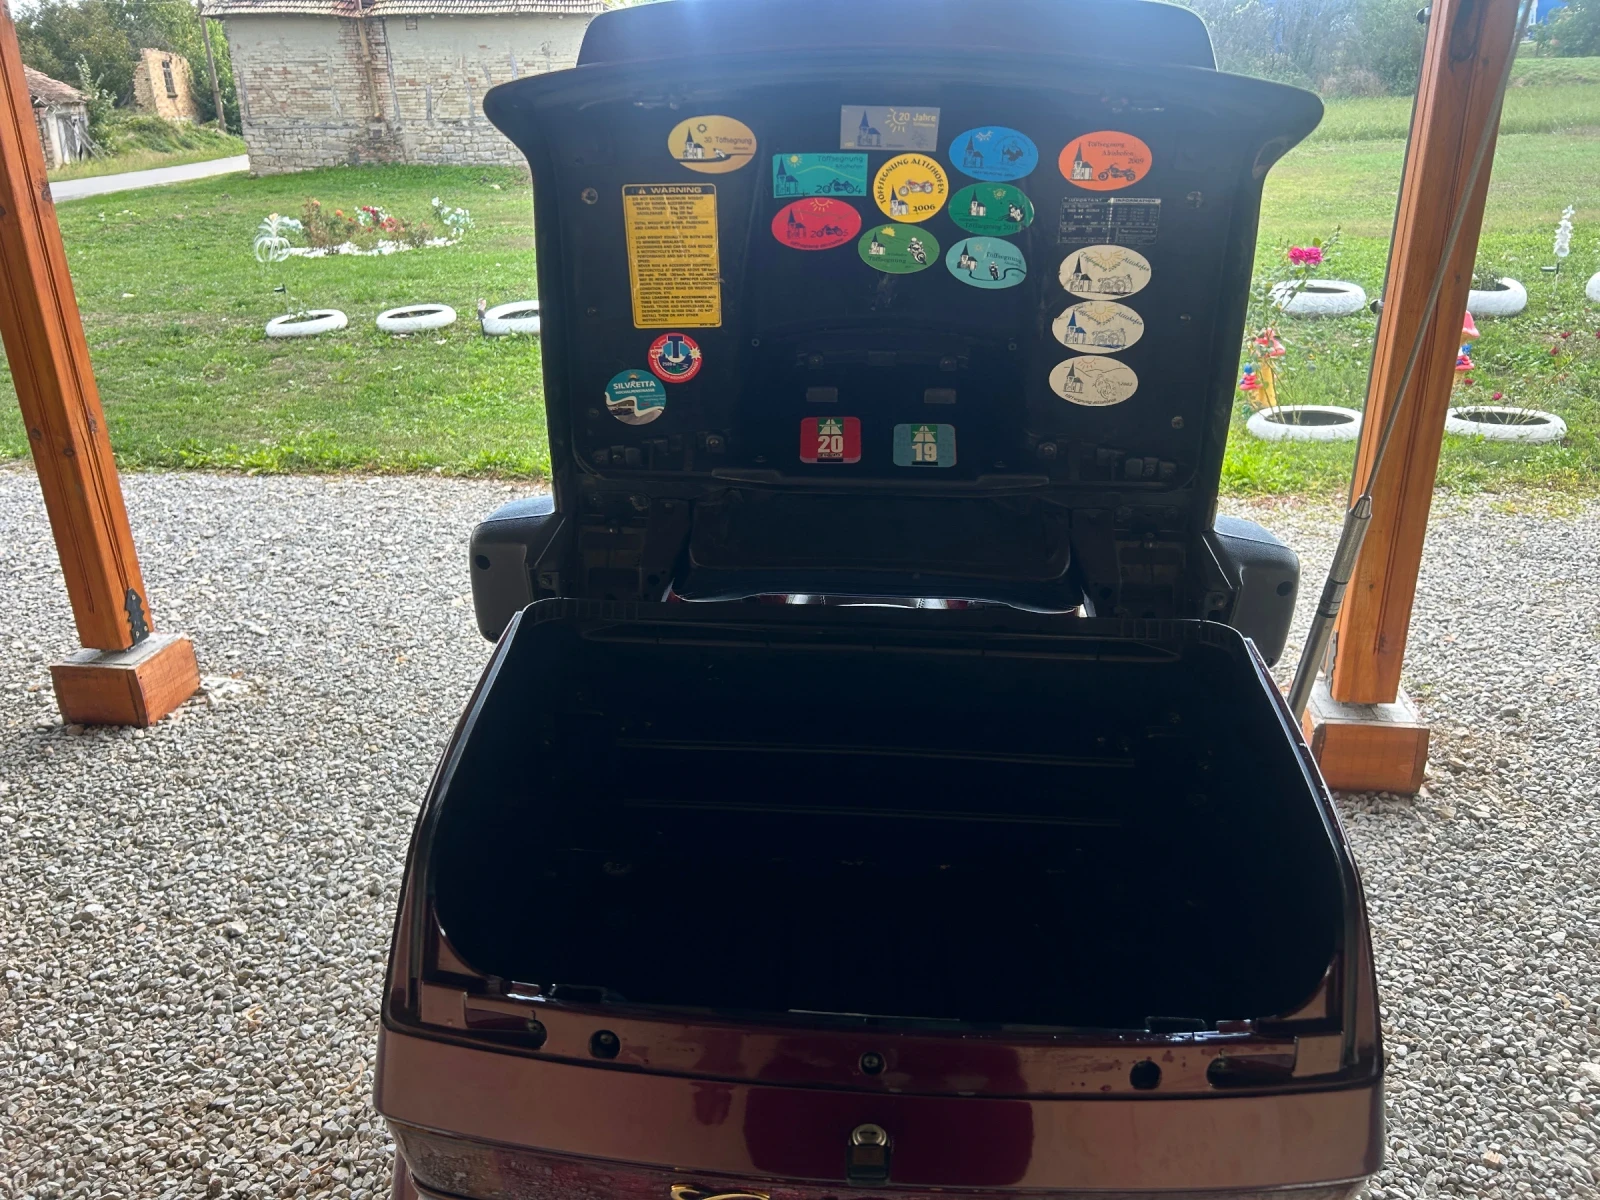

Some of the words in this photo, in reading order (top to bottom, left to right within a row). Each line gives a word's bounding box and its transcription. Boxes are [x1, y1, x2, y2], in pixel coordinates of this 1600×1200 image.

[900, 112, 910, 122] 20
[912, 112, 936, 122] Jahre
[910, 158, 944, 194] ALTISHOFEN
[612, 380, 656, 390] SILVRETTA
[818, 436, 844, 454] 20
[912, 443, 938, 462] 19
